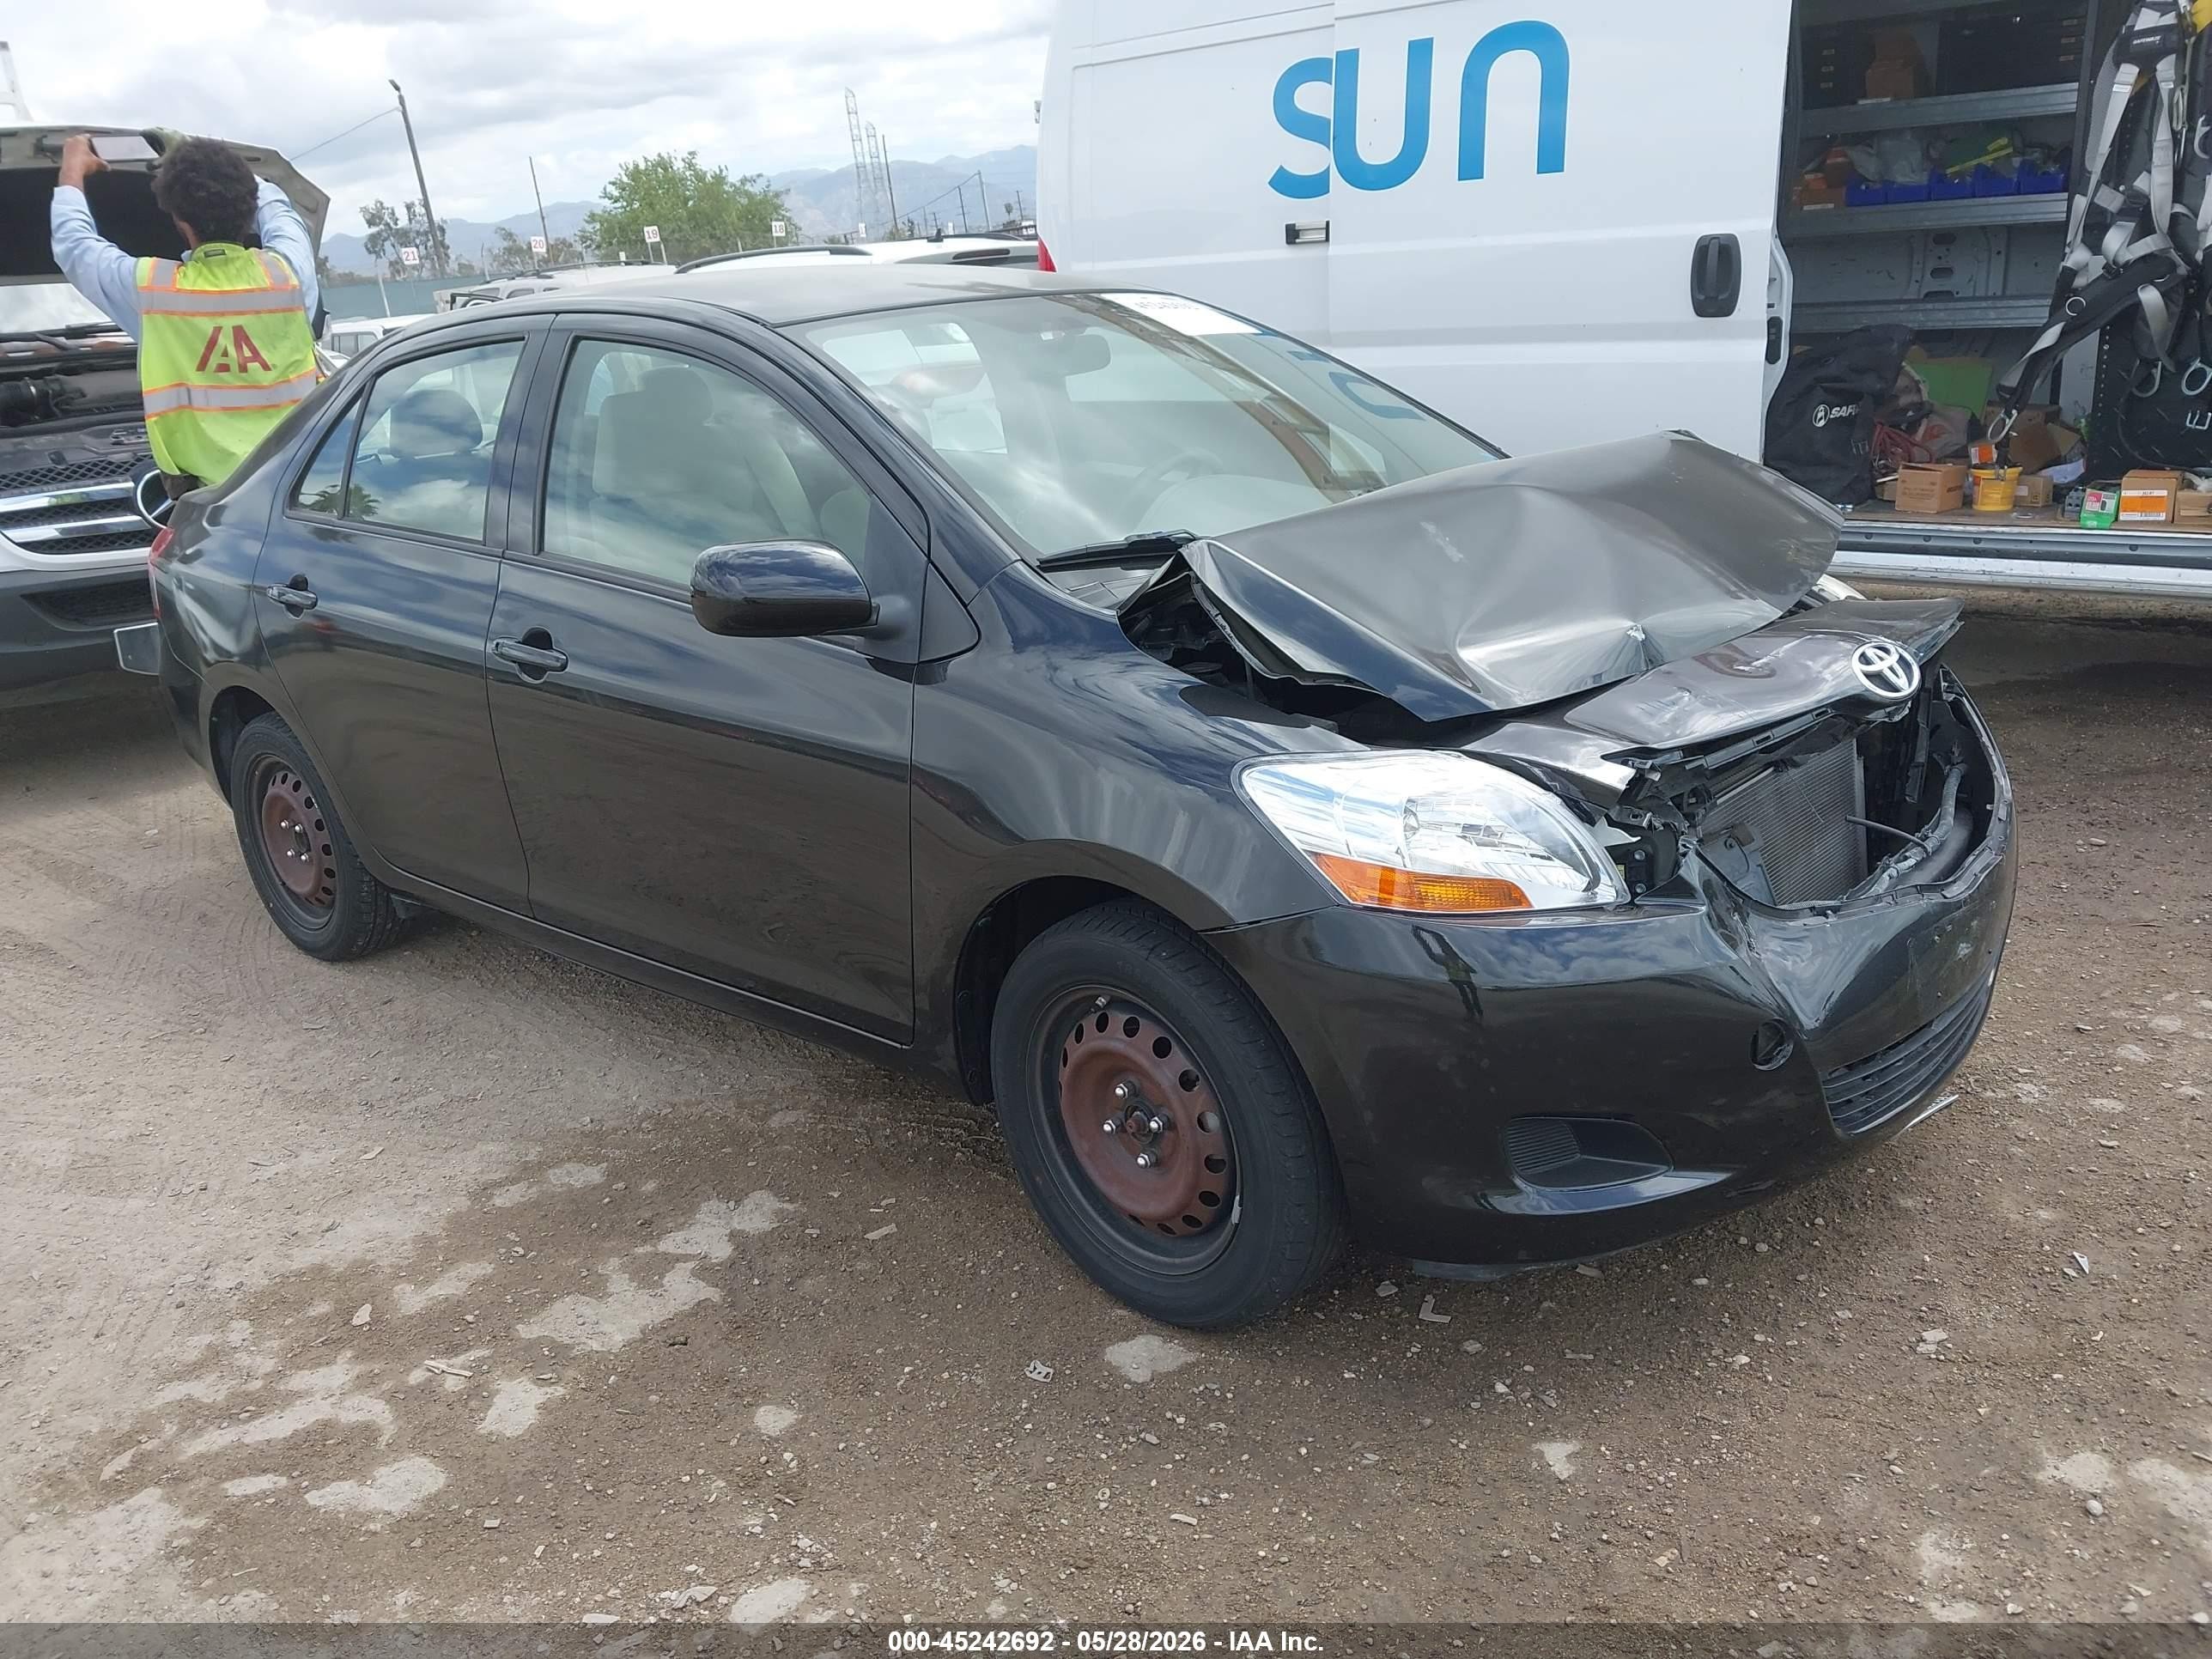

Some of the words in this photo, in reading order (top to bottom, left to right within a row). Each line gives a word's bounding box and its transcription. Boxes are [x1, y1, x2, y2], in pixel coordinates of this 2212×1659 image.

[645, 228, 659, 240] 19
[774, 224, 785, 234] 18
[532, 239, 544, 249] 20
[404, 250, 417, 262] 21
